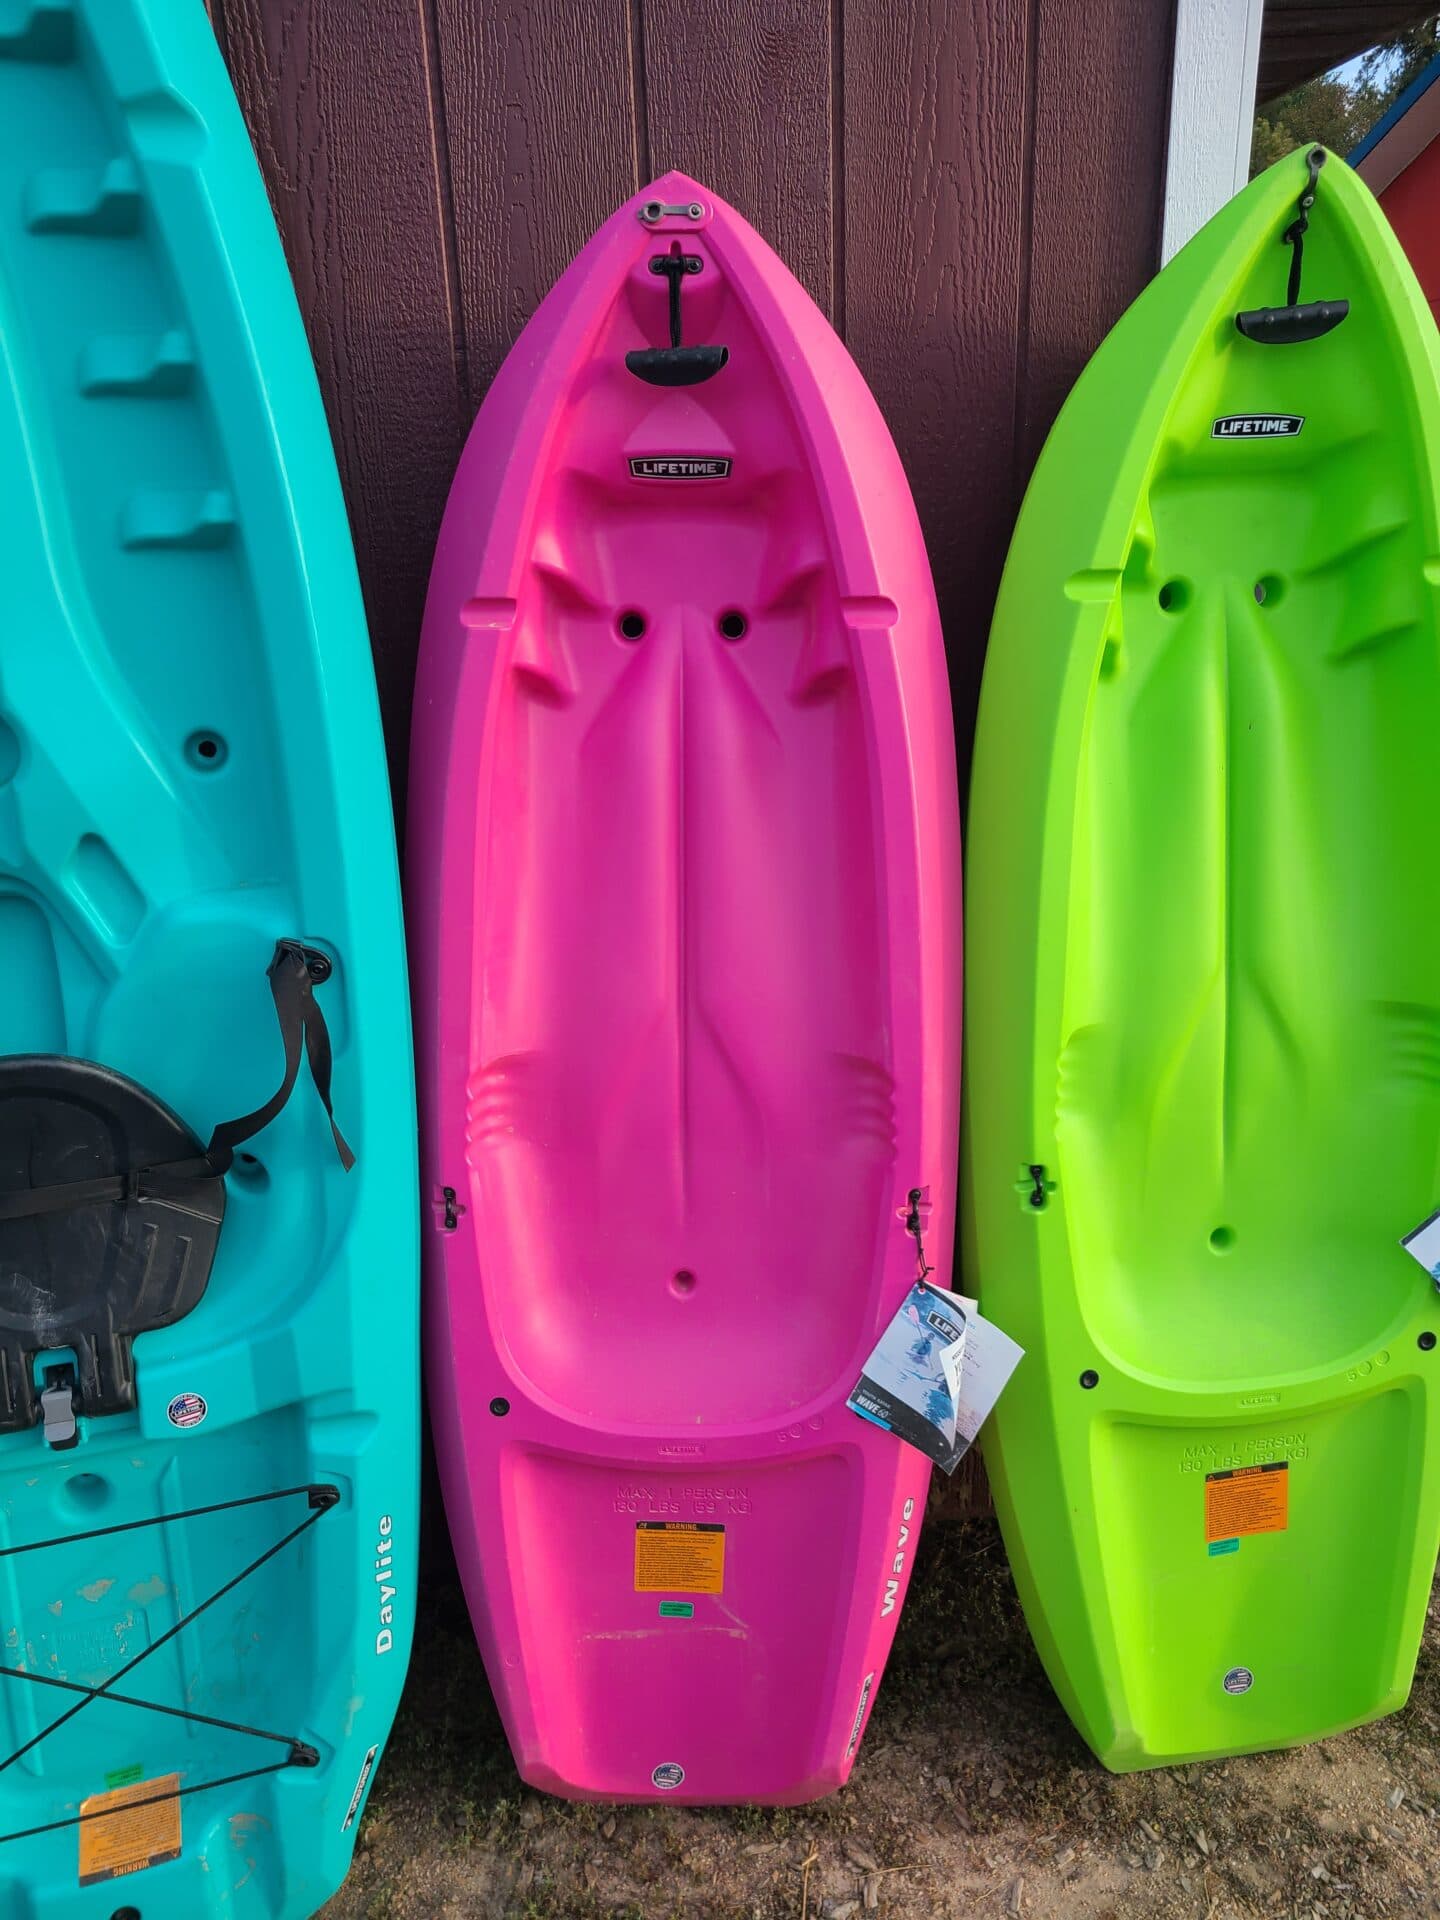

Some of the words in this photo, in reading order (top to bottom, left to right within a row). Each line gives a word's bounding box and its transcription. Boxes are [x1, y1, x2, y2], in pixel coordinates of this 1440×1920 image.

[1220, 419, 1290, 434] LIFETIME
[643, 461, 717, 475] LIFETIME
[856, 1394, 880, 1416] WAVE
[1244, 1433, 1306, 1452] PERSON
[1212, 1455, 1242, 1469] LBS
[682, 1486, 749, 1500] PERSON
[648, 1501, 680, 1514] LBS
[665, 1522, 698, 1531] WARNING
[880, 1497, 914, 1619] Wave
[376, 1515, 396, 1655] Daylite
[112, 1856, 150, 1878] WARNING
